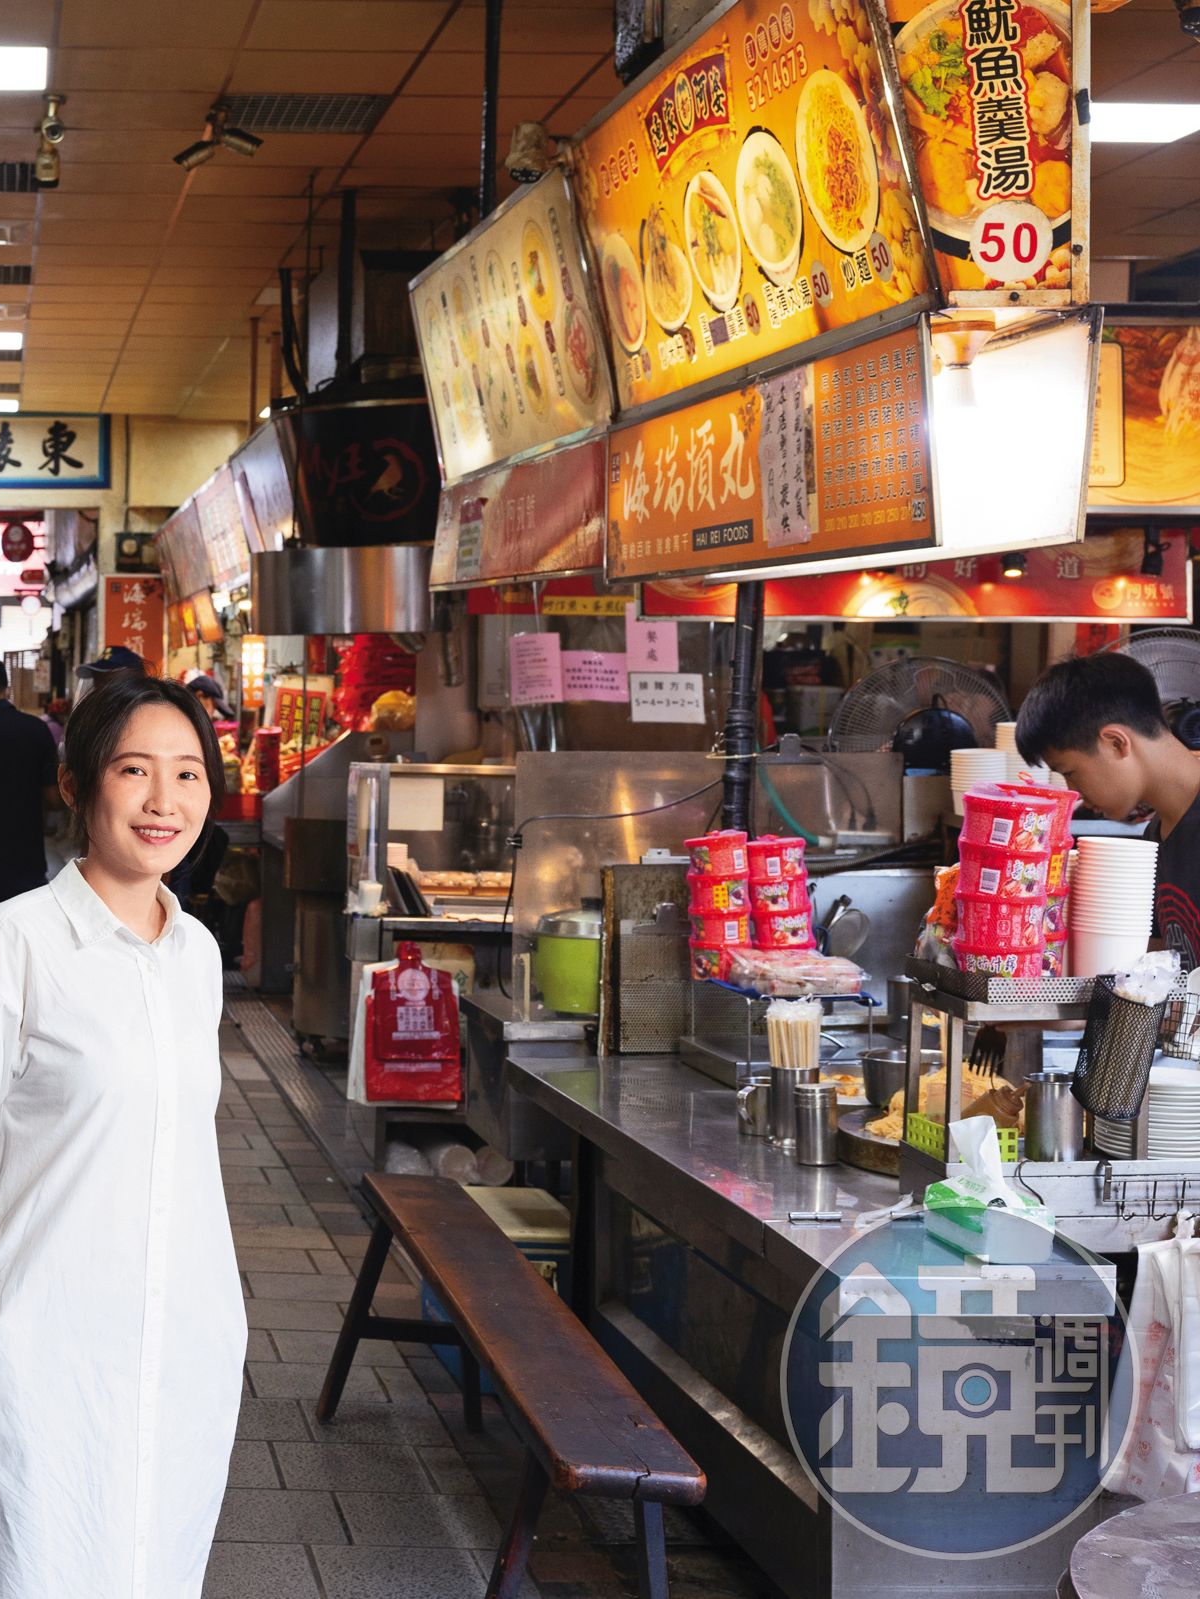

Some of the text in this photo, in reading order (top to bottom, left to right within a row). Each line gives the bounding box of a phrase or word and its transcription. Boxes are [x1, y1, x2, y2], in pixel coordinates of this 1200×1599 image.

[745, 41, 808, 113] 5214673
[964, 0, 1031, 195] 魷魚羹湯
[871, 240, 890, 268] 50
[979, 222, 1039, 264] 50
[812, 270, 830, 299] 50
[695, 525, 750, 547] HAI REI FOODS
